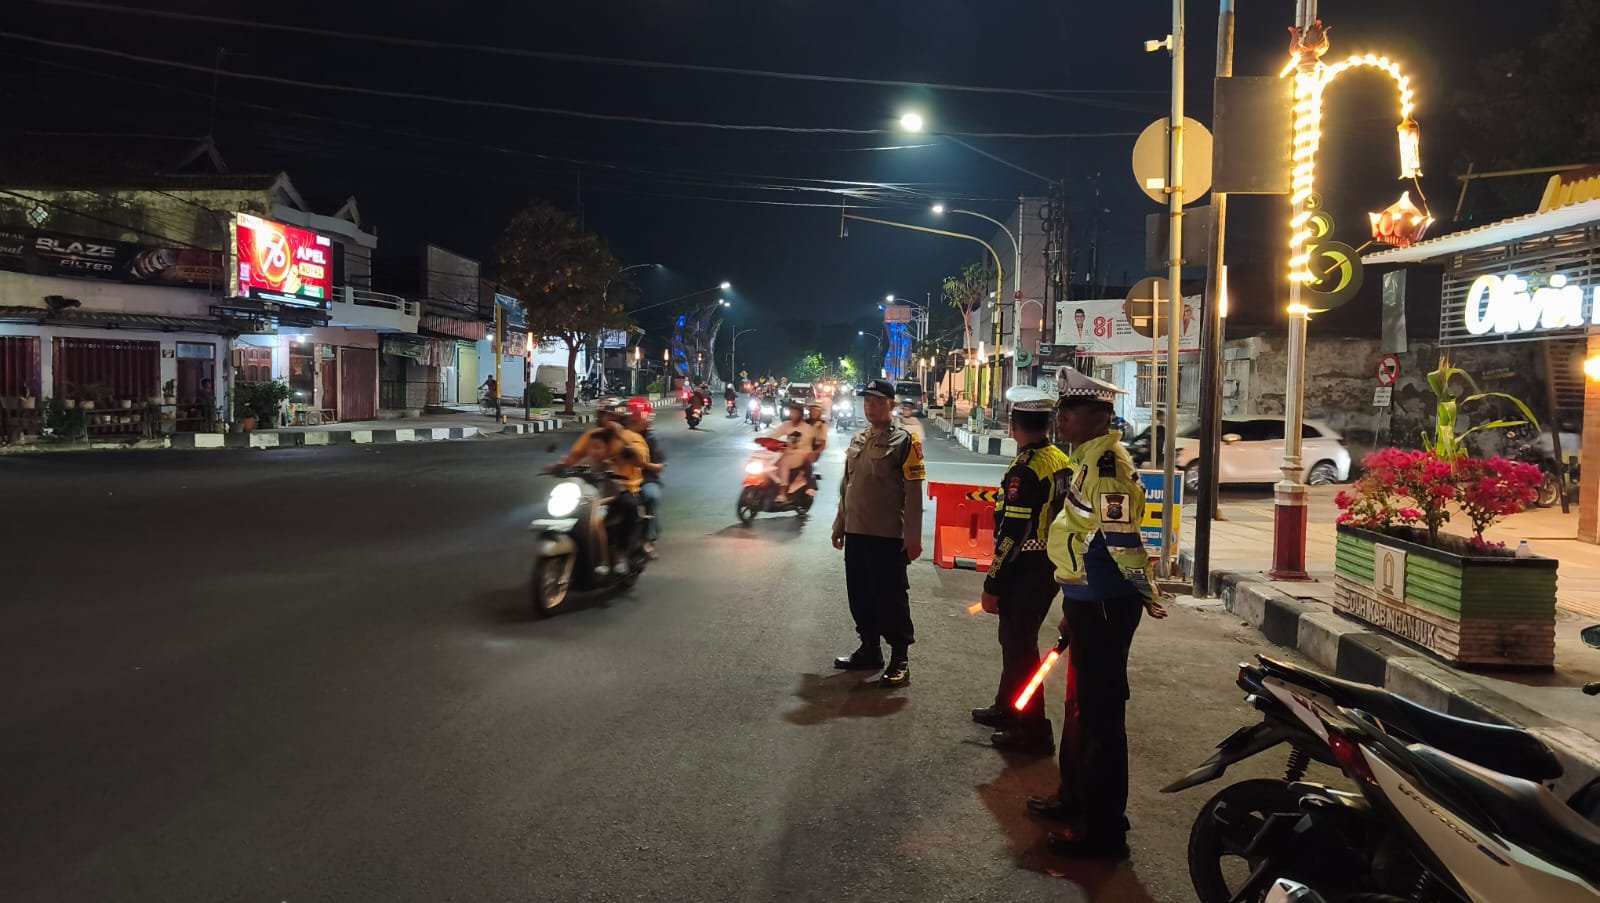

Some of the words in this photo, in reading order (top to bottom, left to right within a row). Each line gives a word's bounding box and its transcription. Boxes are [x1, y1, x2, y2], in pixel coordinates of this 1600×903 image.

[34, 237, 117, 257] BLAZE
[297, 246, 326, 264] APEL
[59, 259, 113, 272] FILTER
